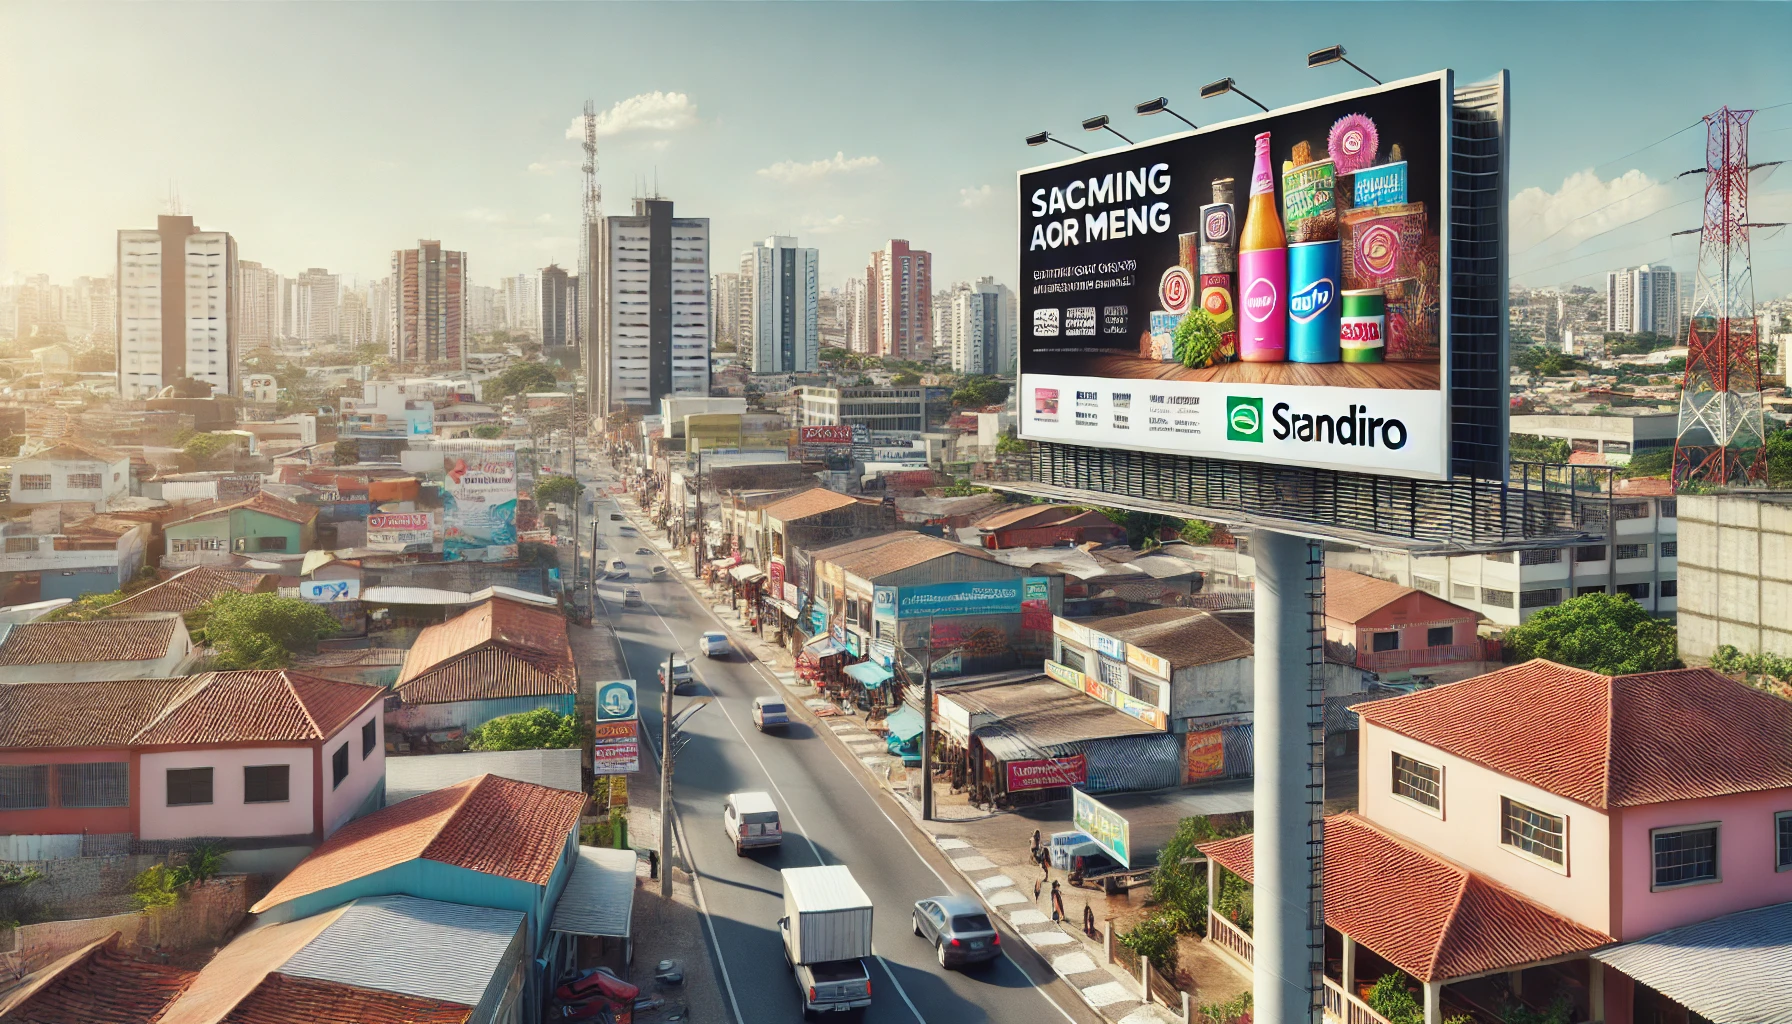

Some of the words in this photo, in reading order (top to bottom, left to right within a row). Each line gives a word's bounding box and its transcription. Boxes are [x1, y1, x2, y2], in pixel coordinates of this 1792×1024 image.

[1031, 163, 1171, 218] SACMING
[1030, 218, 1080, 251] AOR
[1085, 202, 1171, 243] MENG
